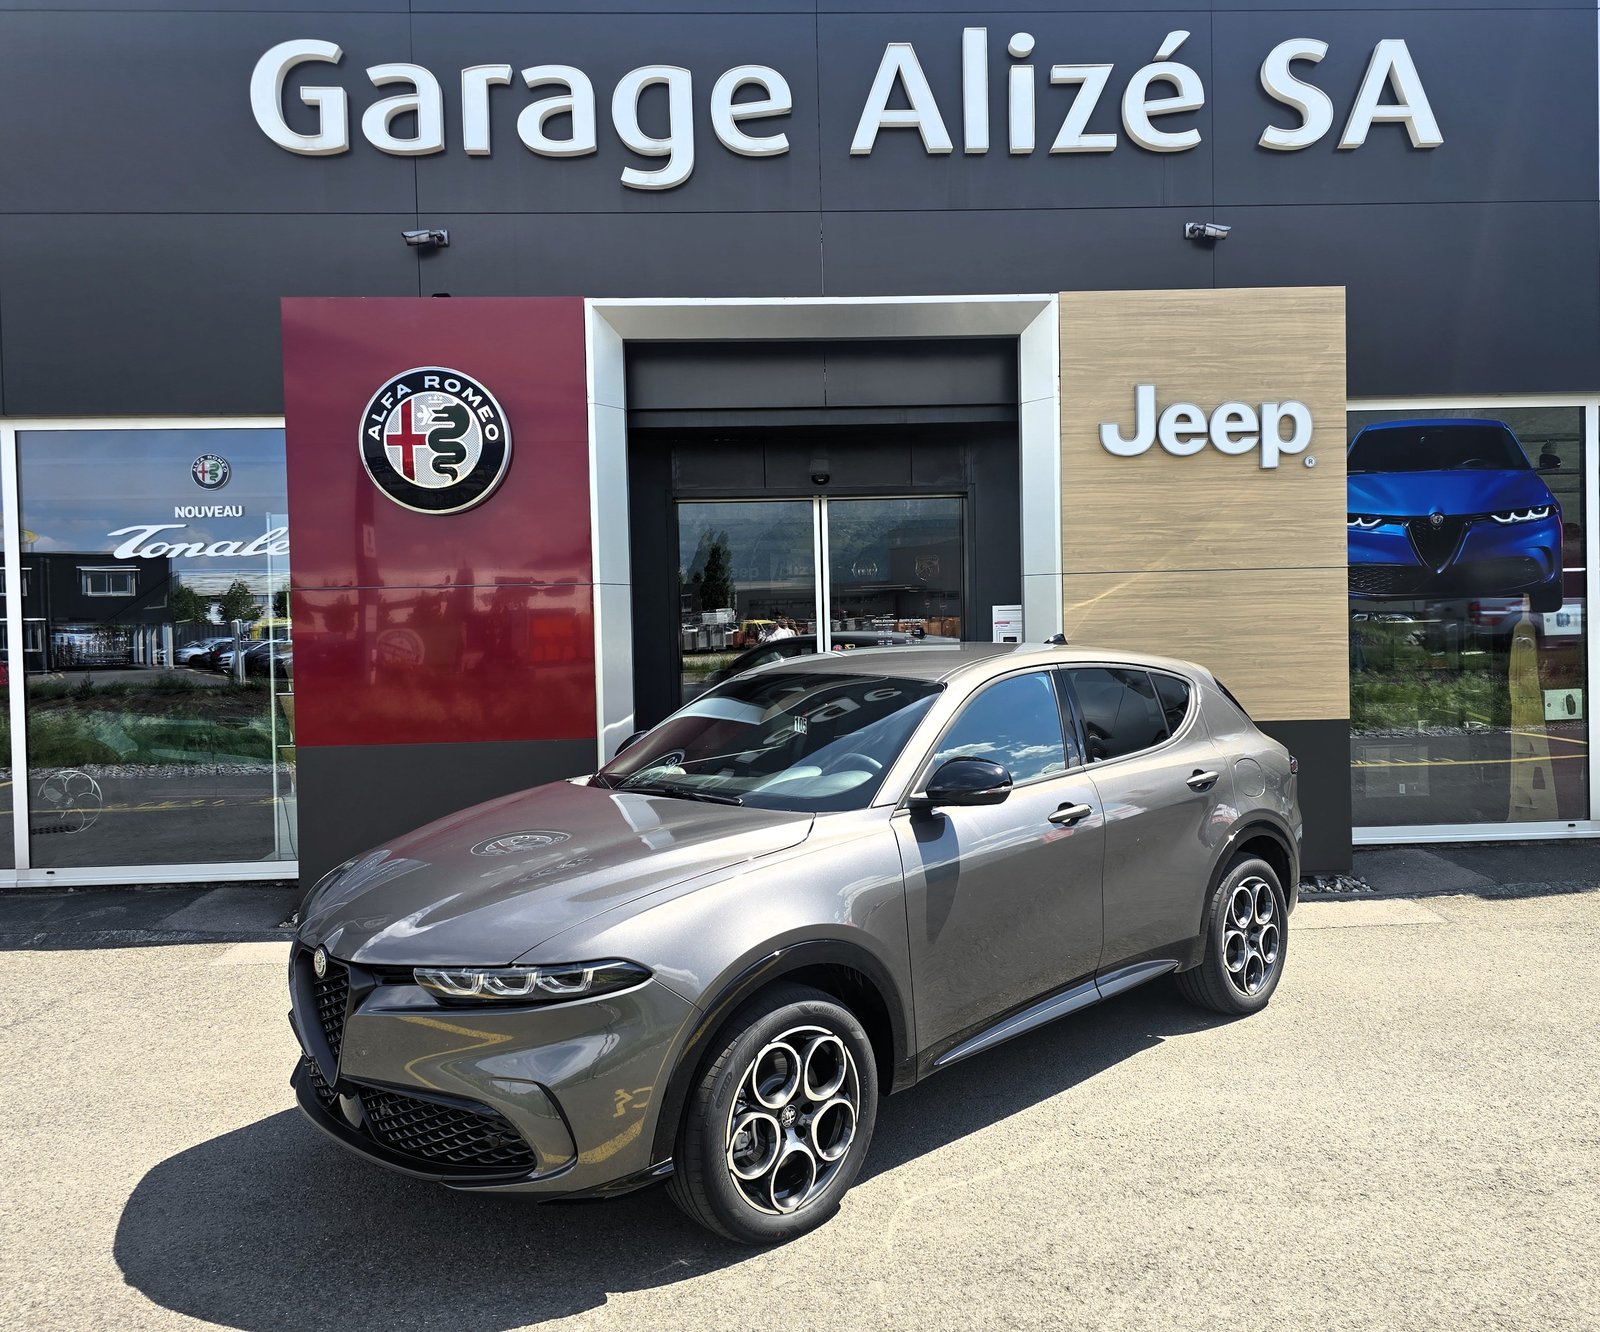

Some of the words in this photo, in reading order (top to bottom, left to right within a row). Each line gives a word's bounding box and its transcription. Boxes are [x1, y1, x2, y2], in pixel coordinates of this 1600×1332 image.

[250, 39, 793, 190] Garage
[850, 27, 1205, 155] Alizé
[1258, 38, 1444, 151] SA
[368, 383, 412, 441] ALFA
[424, 376, 499, 441] ROMEO
[1098, 383, 1314, 469] Jeep
[193, 457, 205, 472] ALFA
[207, 455, 228, 473] ROMEO
[174, 505, 243, 518] NOUVEAU
[107, 524, 290, 560] Tonale
